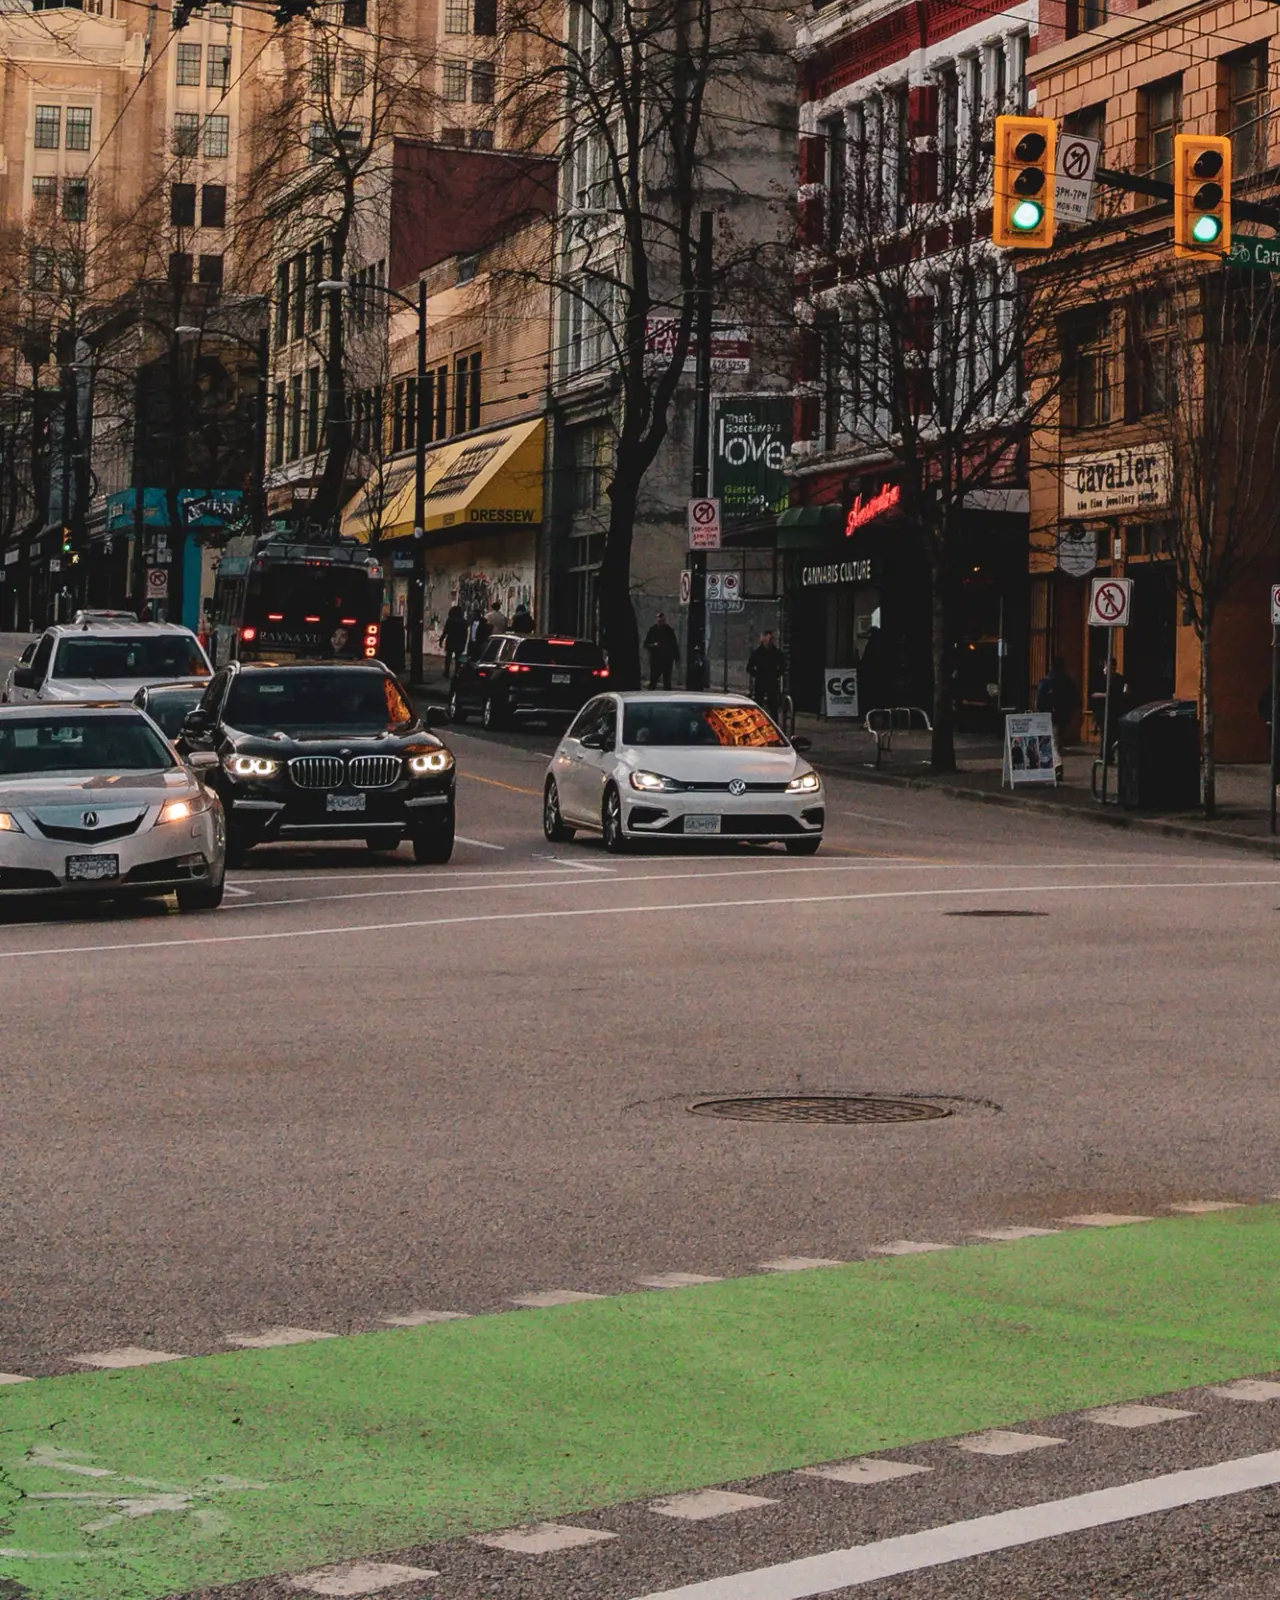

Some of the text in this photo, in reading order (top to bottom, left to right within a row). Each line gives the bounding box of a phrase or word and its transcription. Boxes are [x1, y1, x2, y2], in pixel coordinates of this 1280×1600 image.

[1055, 186, 1088, 200] 3PM-7PM
[470, 509, 535, 522] DRESSEW
[802, 559, 871, 586] CANNABIS CULTURE
